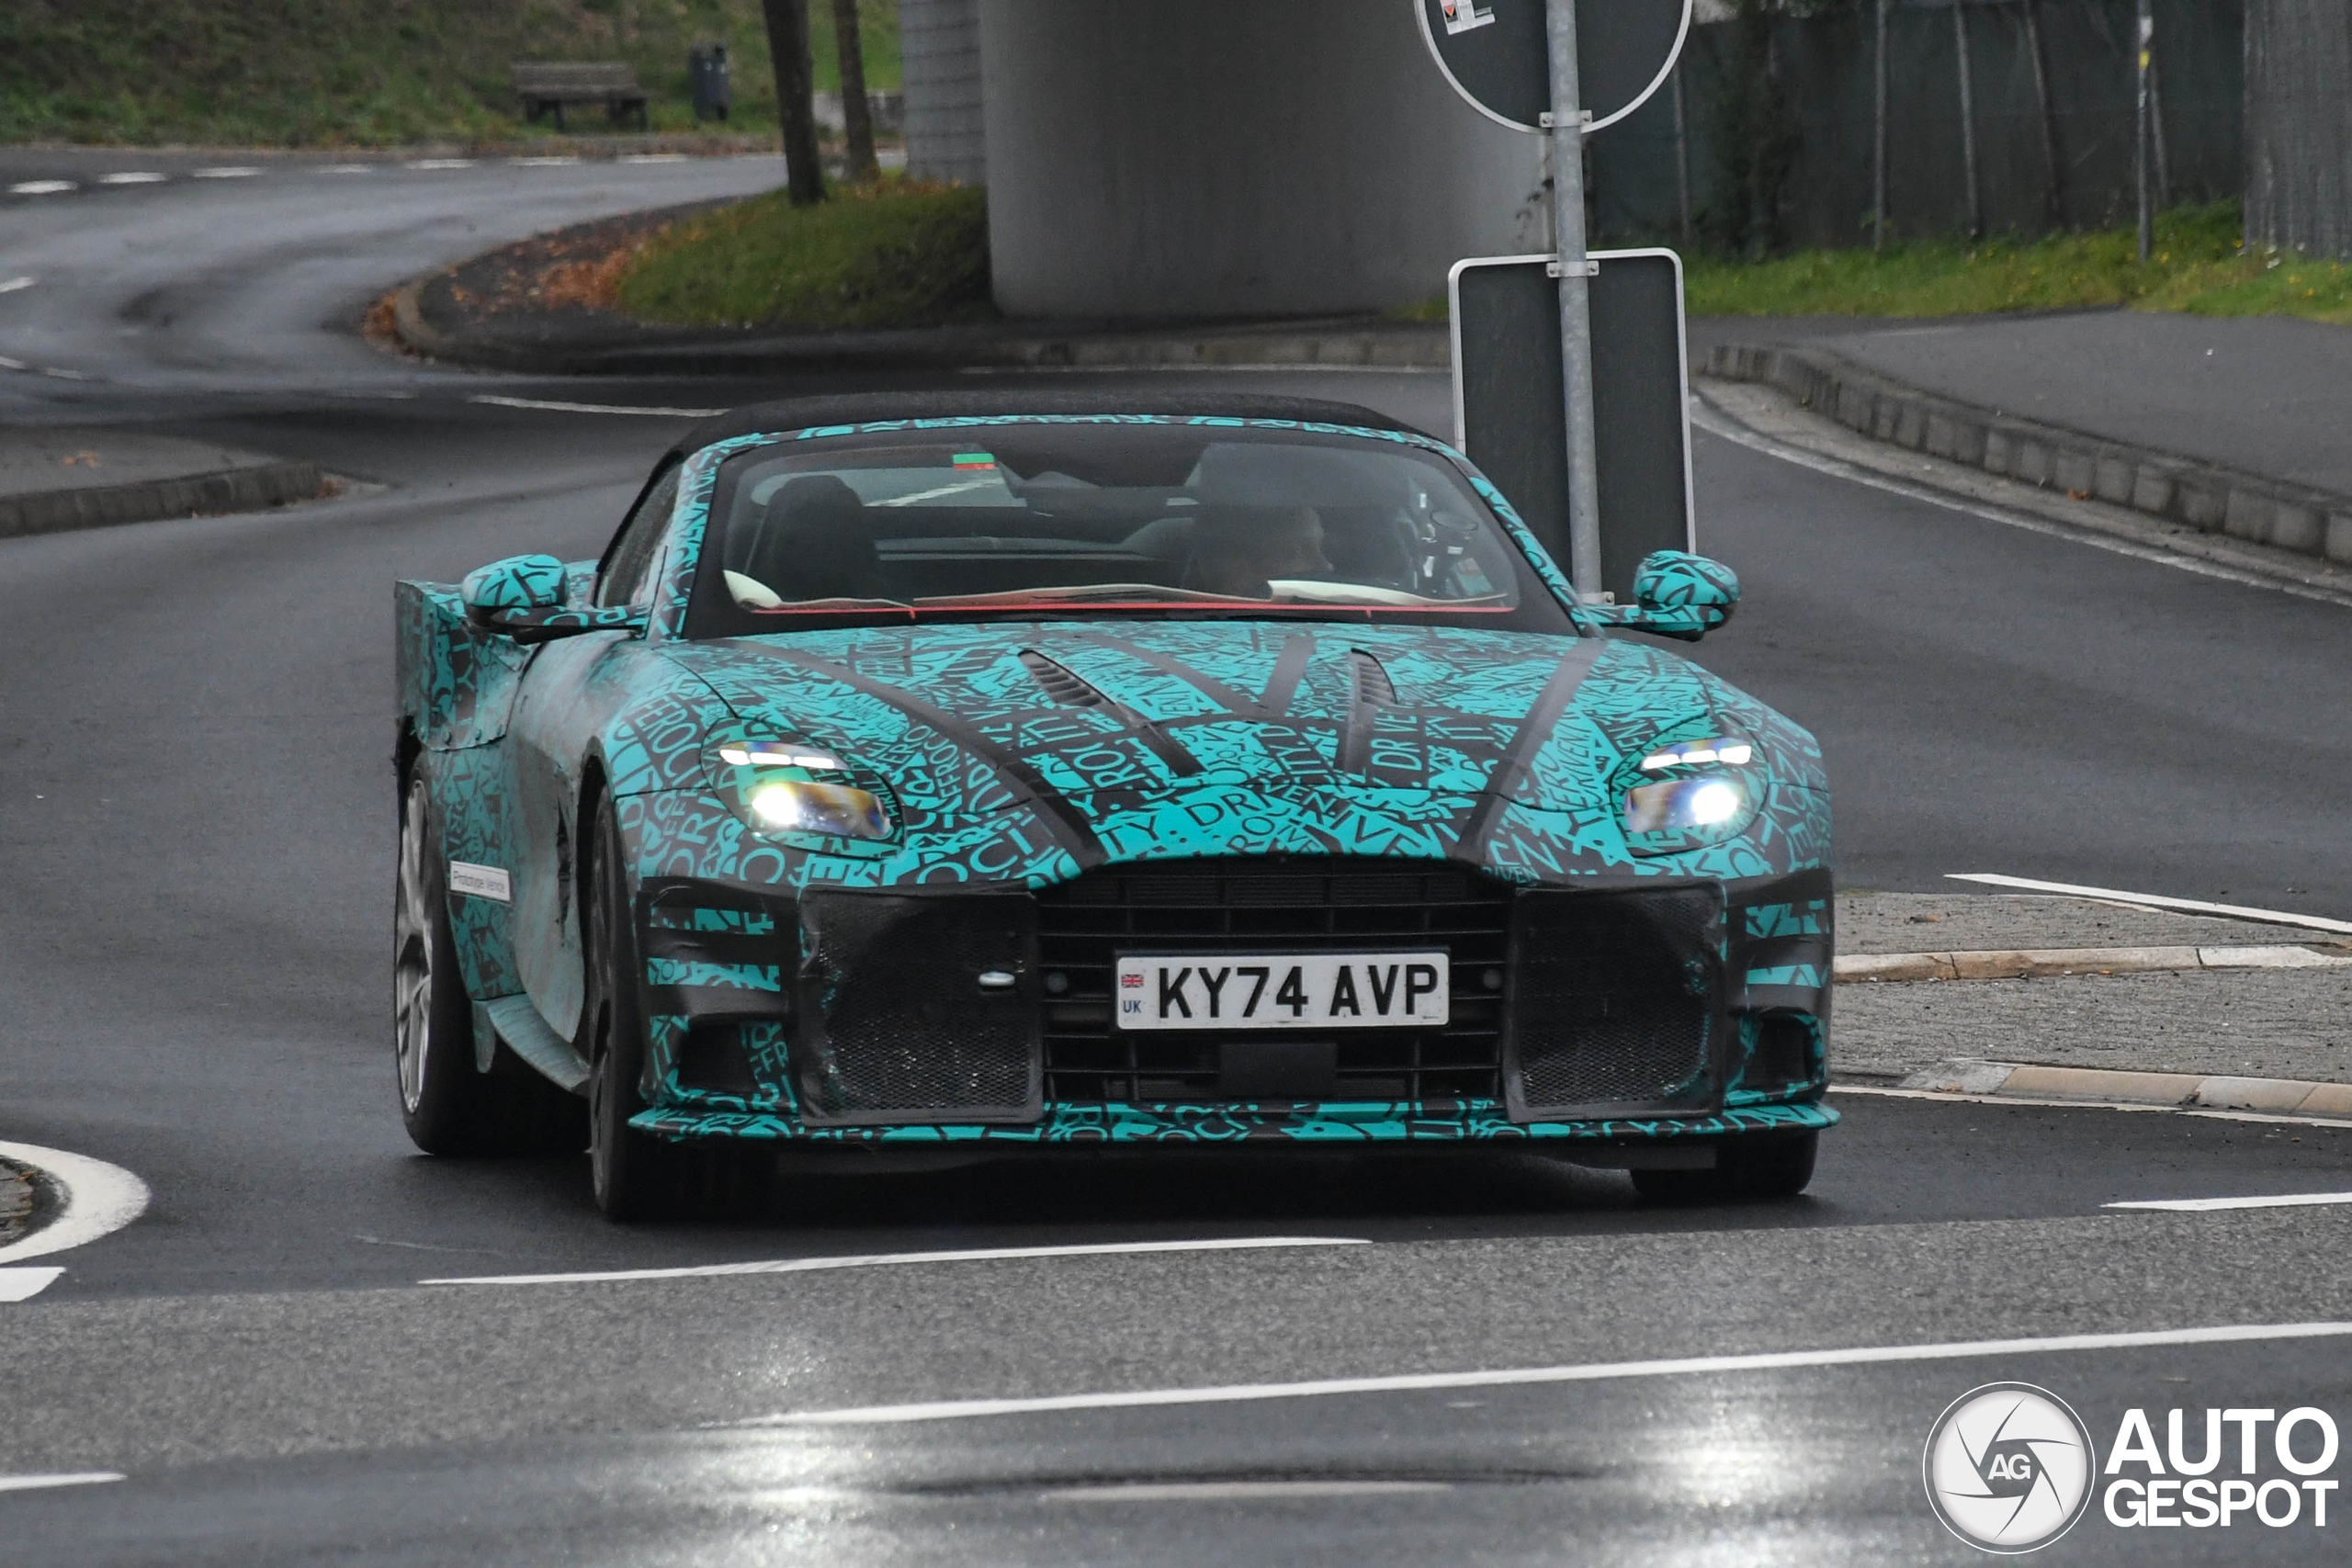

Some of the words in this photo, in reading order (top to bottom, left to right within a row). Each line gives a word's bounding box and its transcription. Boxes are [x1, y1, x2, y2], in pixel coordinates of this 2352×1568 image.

[1123, 1000, 1142, 1014] UK
[1159, 966, 1309, 1018] KY74
[1329, 964, 1439, 1016] AVP
